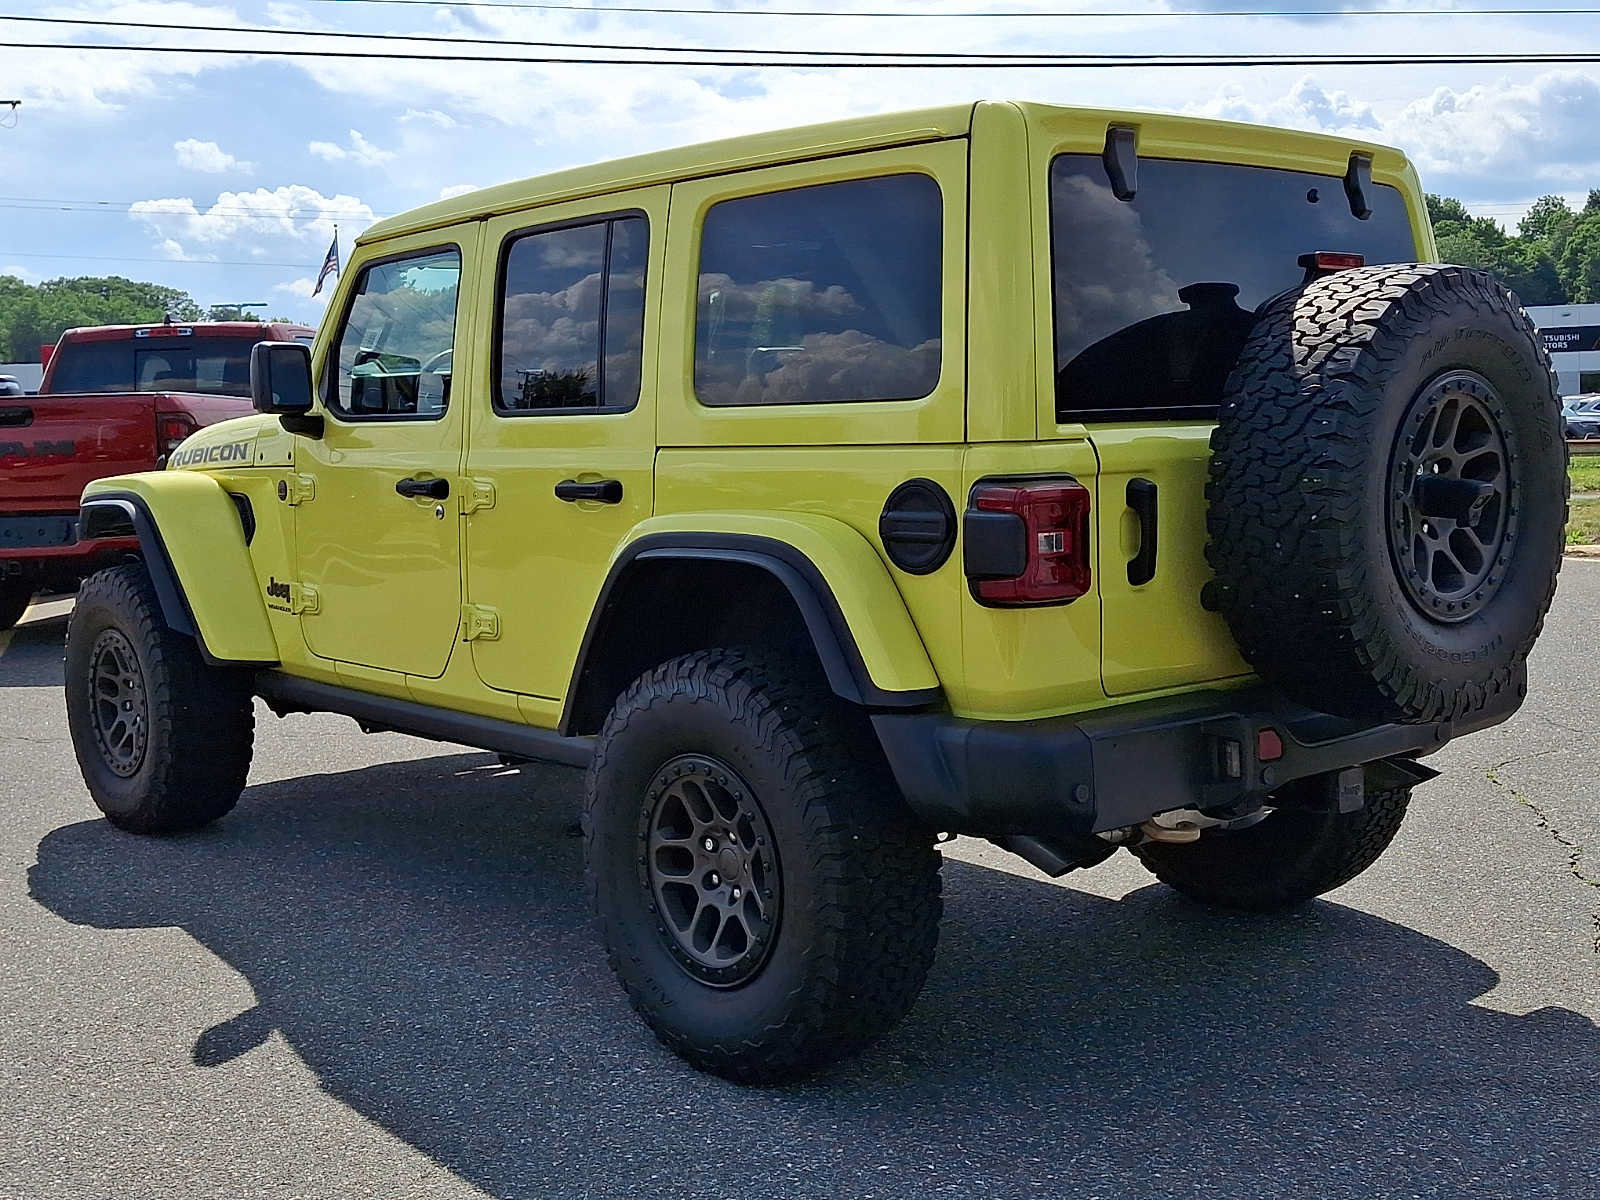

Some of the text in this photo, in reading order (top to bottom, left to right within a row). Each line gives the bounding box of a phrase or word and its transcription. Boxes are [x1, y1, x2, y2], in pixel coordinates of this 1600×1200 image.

[1543, 333, 1580, 342] TSUBISHI
[0, 440, 76, 458] AM
[171, 443, 248, 468] RUBICON
[266, 576, 291, 603] Jeep
